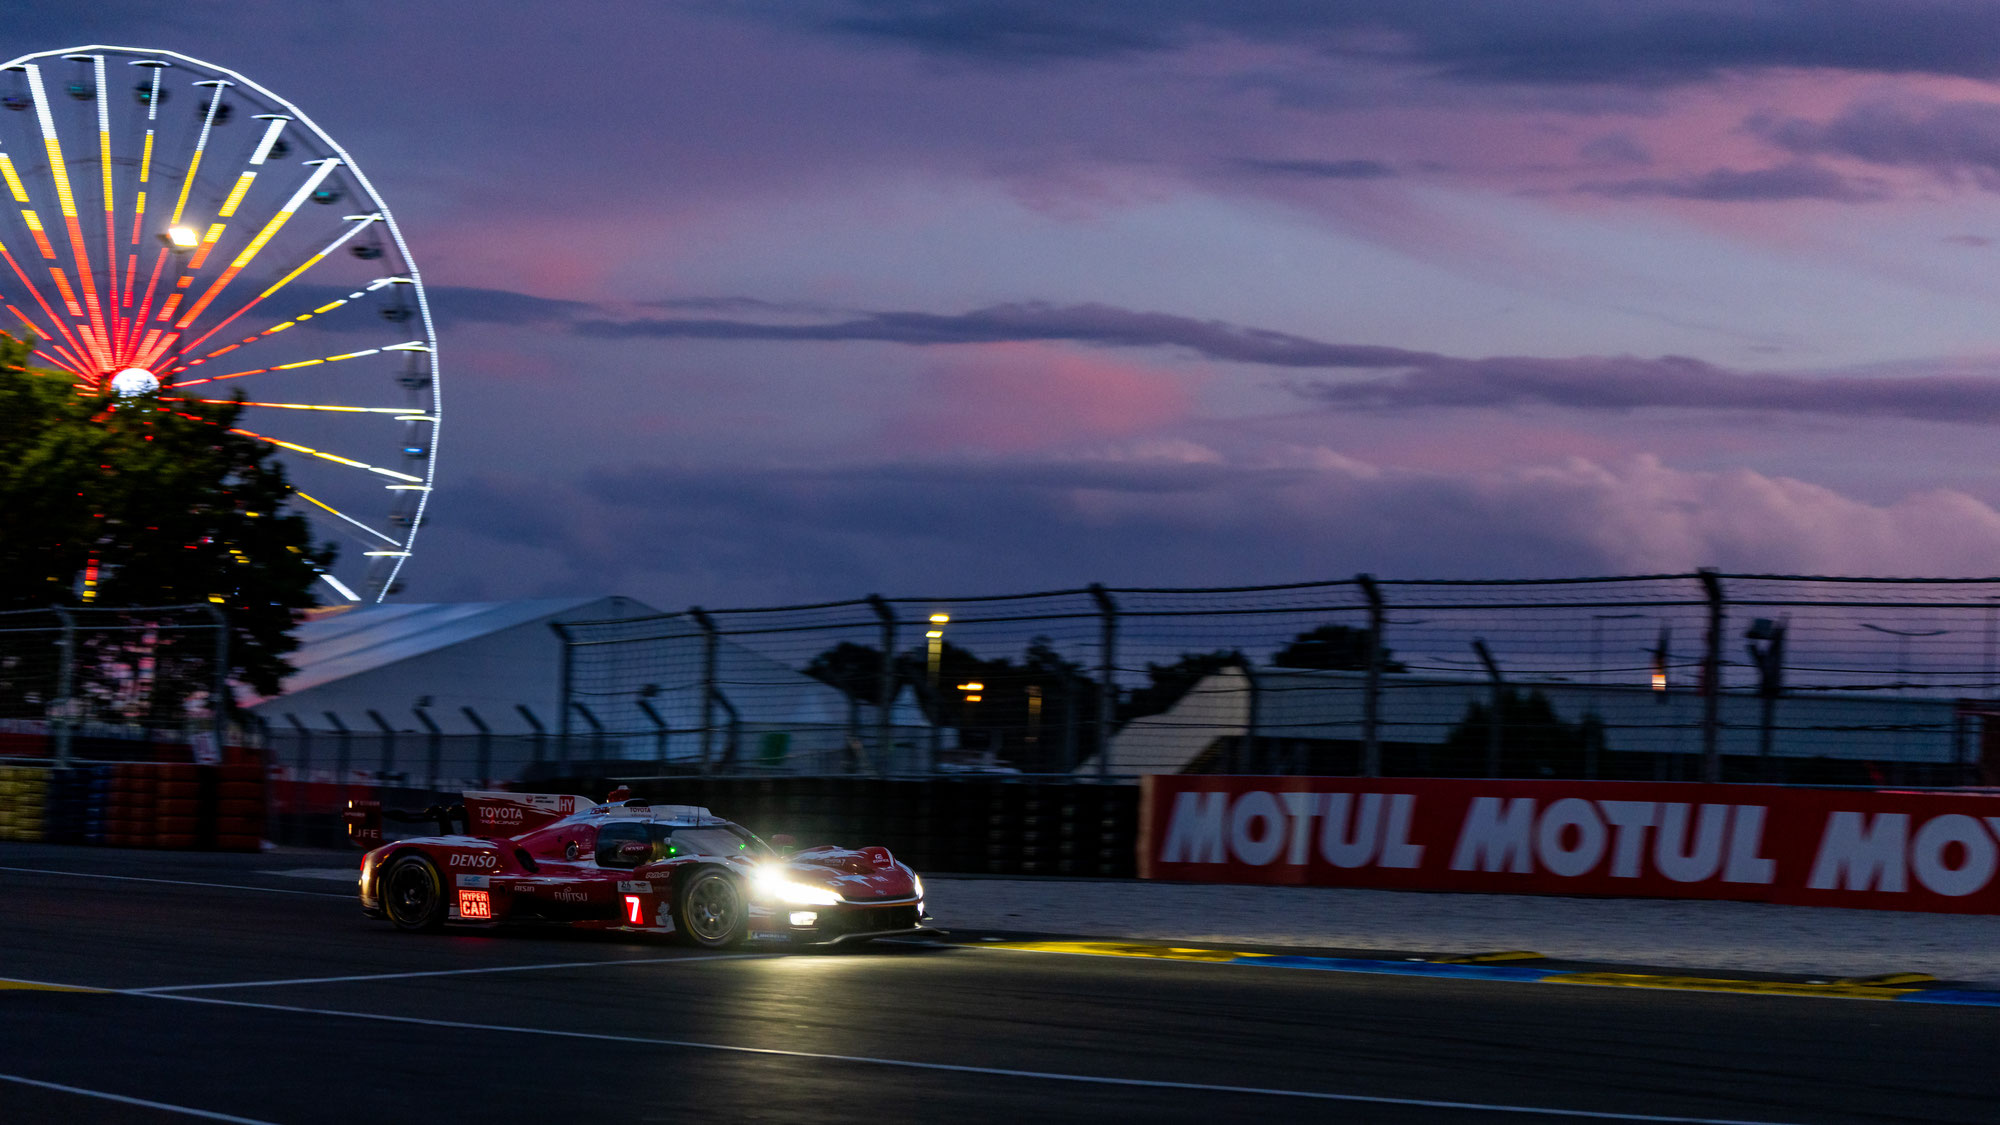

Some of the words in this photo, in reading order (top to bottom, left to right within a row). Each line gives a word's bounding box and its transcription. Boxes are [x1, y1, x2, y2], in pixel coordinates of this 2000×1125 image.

[478, 806, 523, 819] TOYOTA
[561, 799, 574, 813] HY
[353, 829, 379, 839] JFE
[1159, 790, 1417, 869] MOTUL
[1448, 796, 1777, 885] MOTUL
[449, 854, 497, 868] DENSO
[462, 892, 486, 902] HYPER
[554, 886, 588, 903] FUJITSU
[463, 901, 488, 916] CAR
[625, 896, 640, 922] 7
